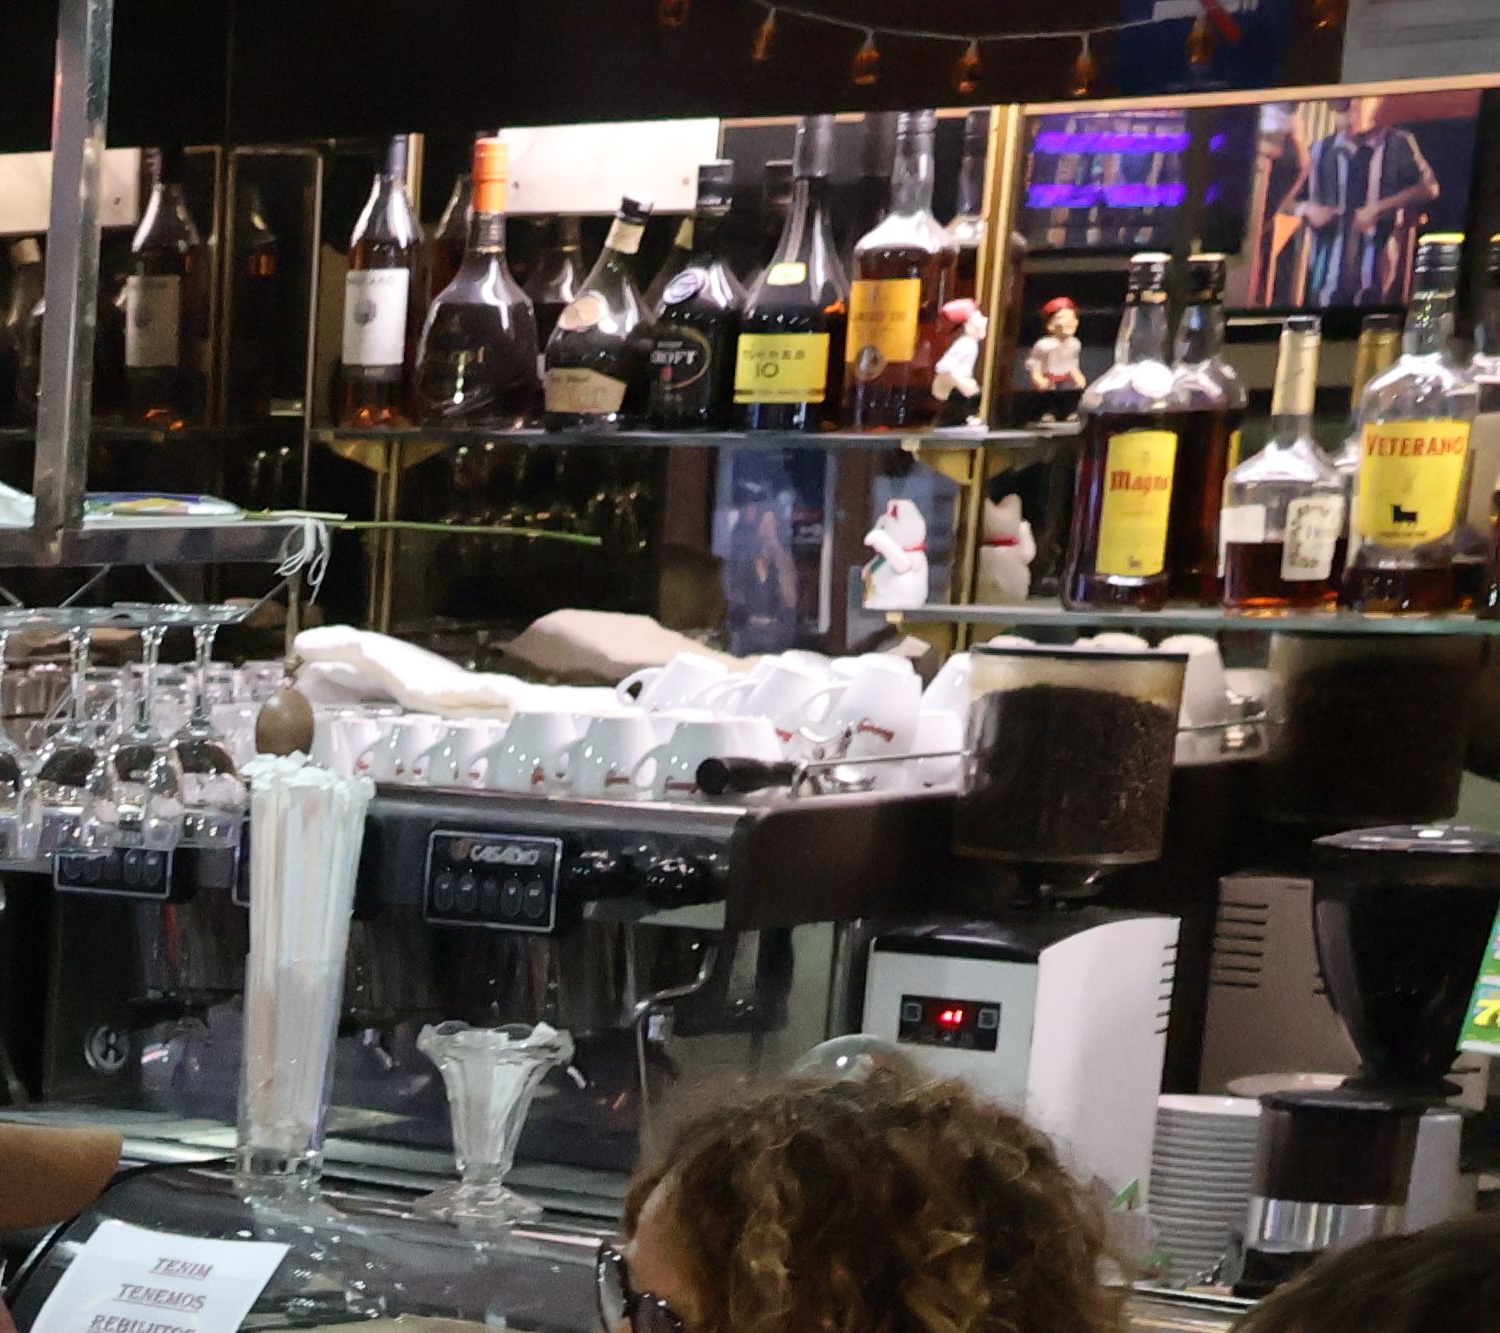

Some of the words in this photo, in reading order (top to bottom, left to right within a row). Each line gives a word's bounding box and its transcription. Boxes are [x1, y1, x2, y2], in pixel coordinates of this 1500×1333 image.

[755, 362, 780, 379] 10
[1365, 432, 1465, 458] VETERANO
[153, 1257, 214, 1280] TENIM
[117, 1283, 206, 1310] TENEMOS
